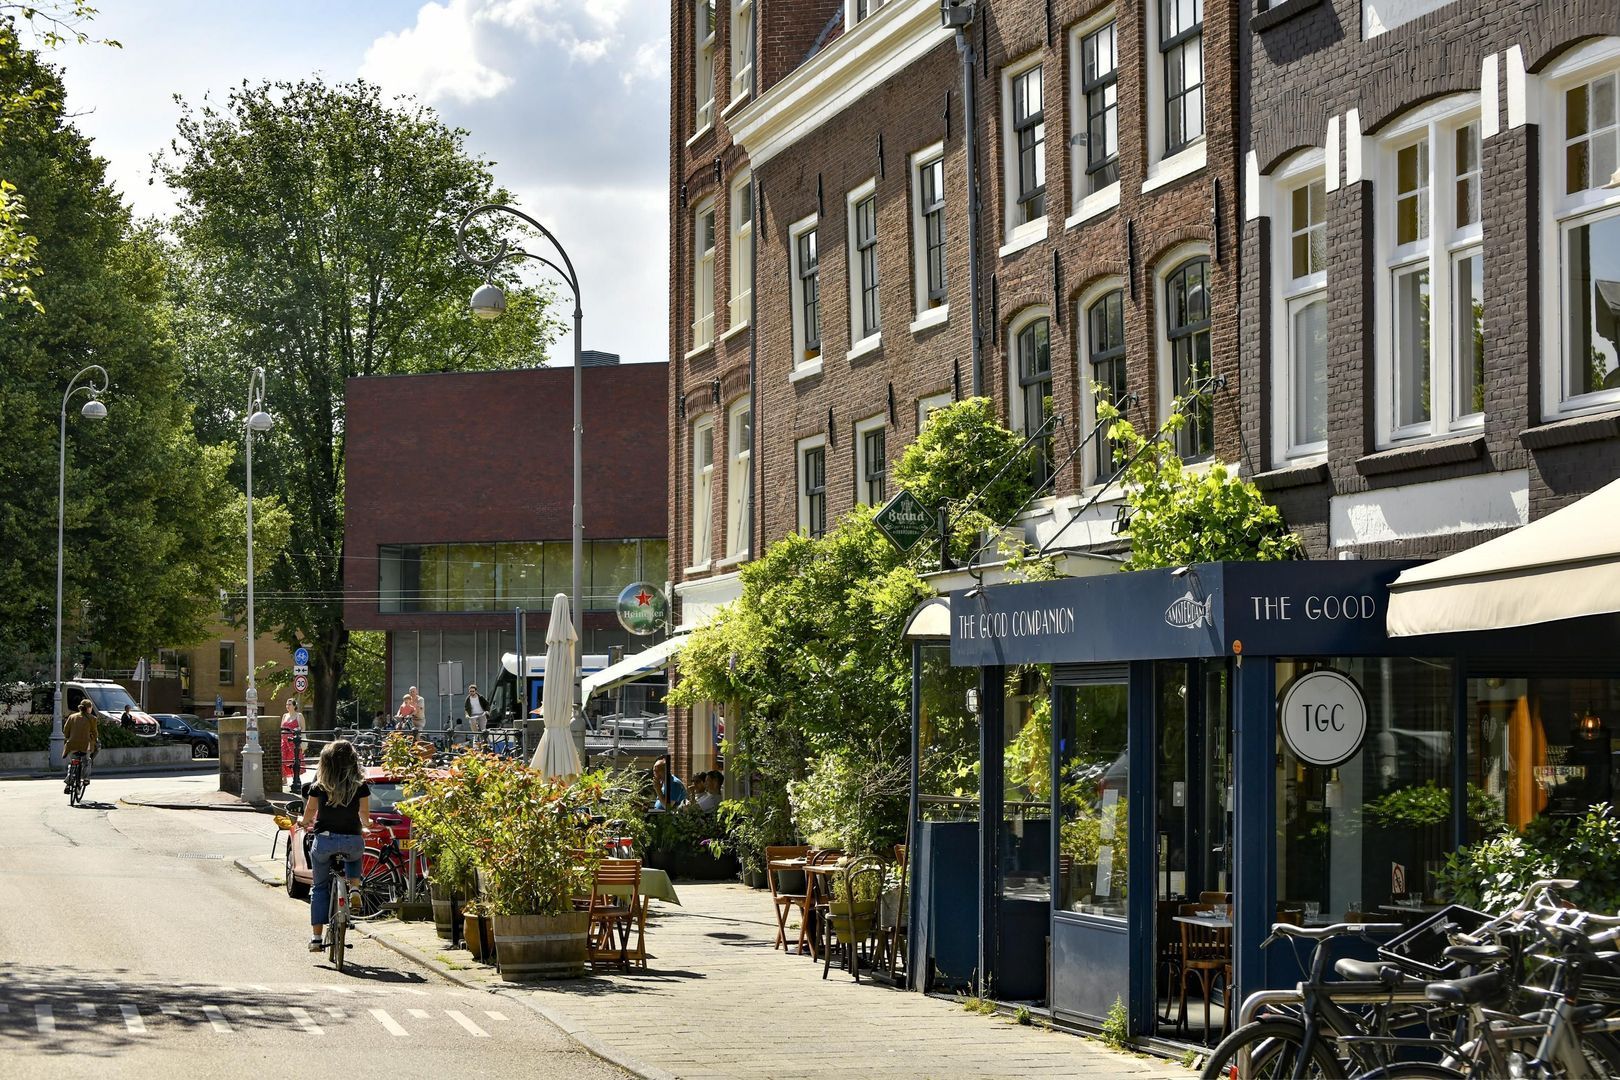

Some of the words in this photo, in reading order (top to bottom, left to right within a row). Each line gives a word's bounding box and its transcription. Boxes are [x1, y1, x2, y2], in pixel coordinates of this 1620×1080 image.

[888, 509, 925, 522] Brand
[1167, 601, 1205, 623] AMSTERDAM
[1250, 596, 1292, 620] THE
[1305, 595, 1376, 620] GOOD
[959, 614, 975, 639] THE
[980, 612, 1008, 639] GOOD
[1012, 607, 1075, 637] COMPANION
[1302, 703, 1345, 732] TGC
